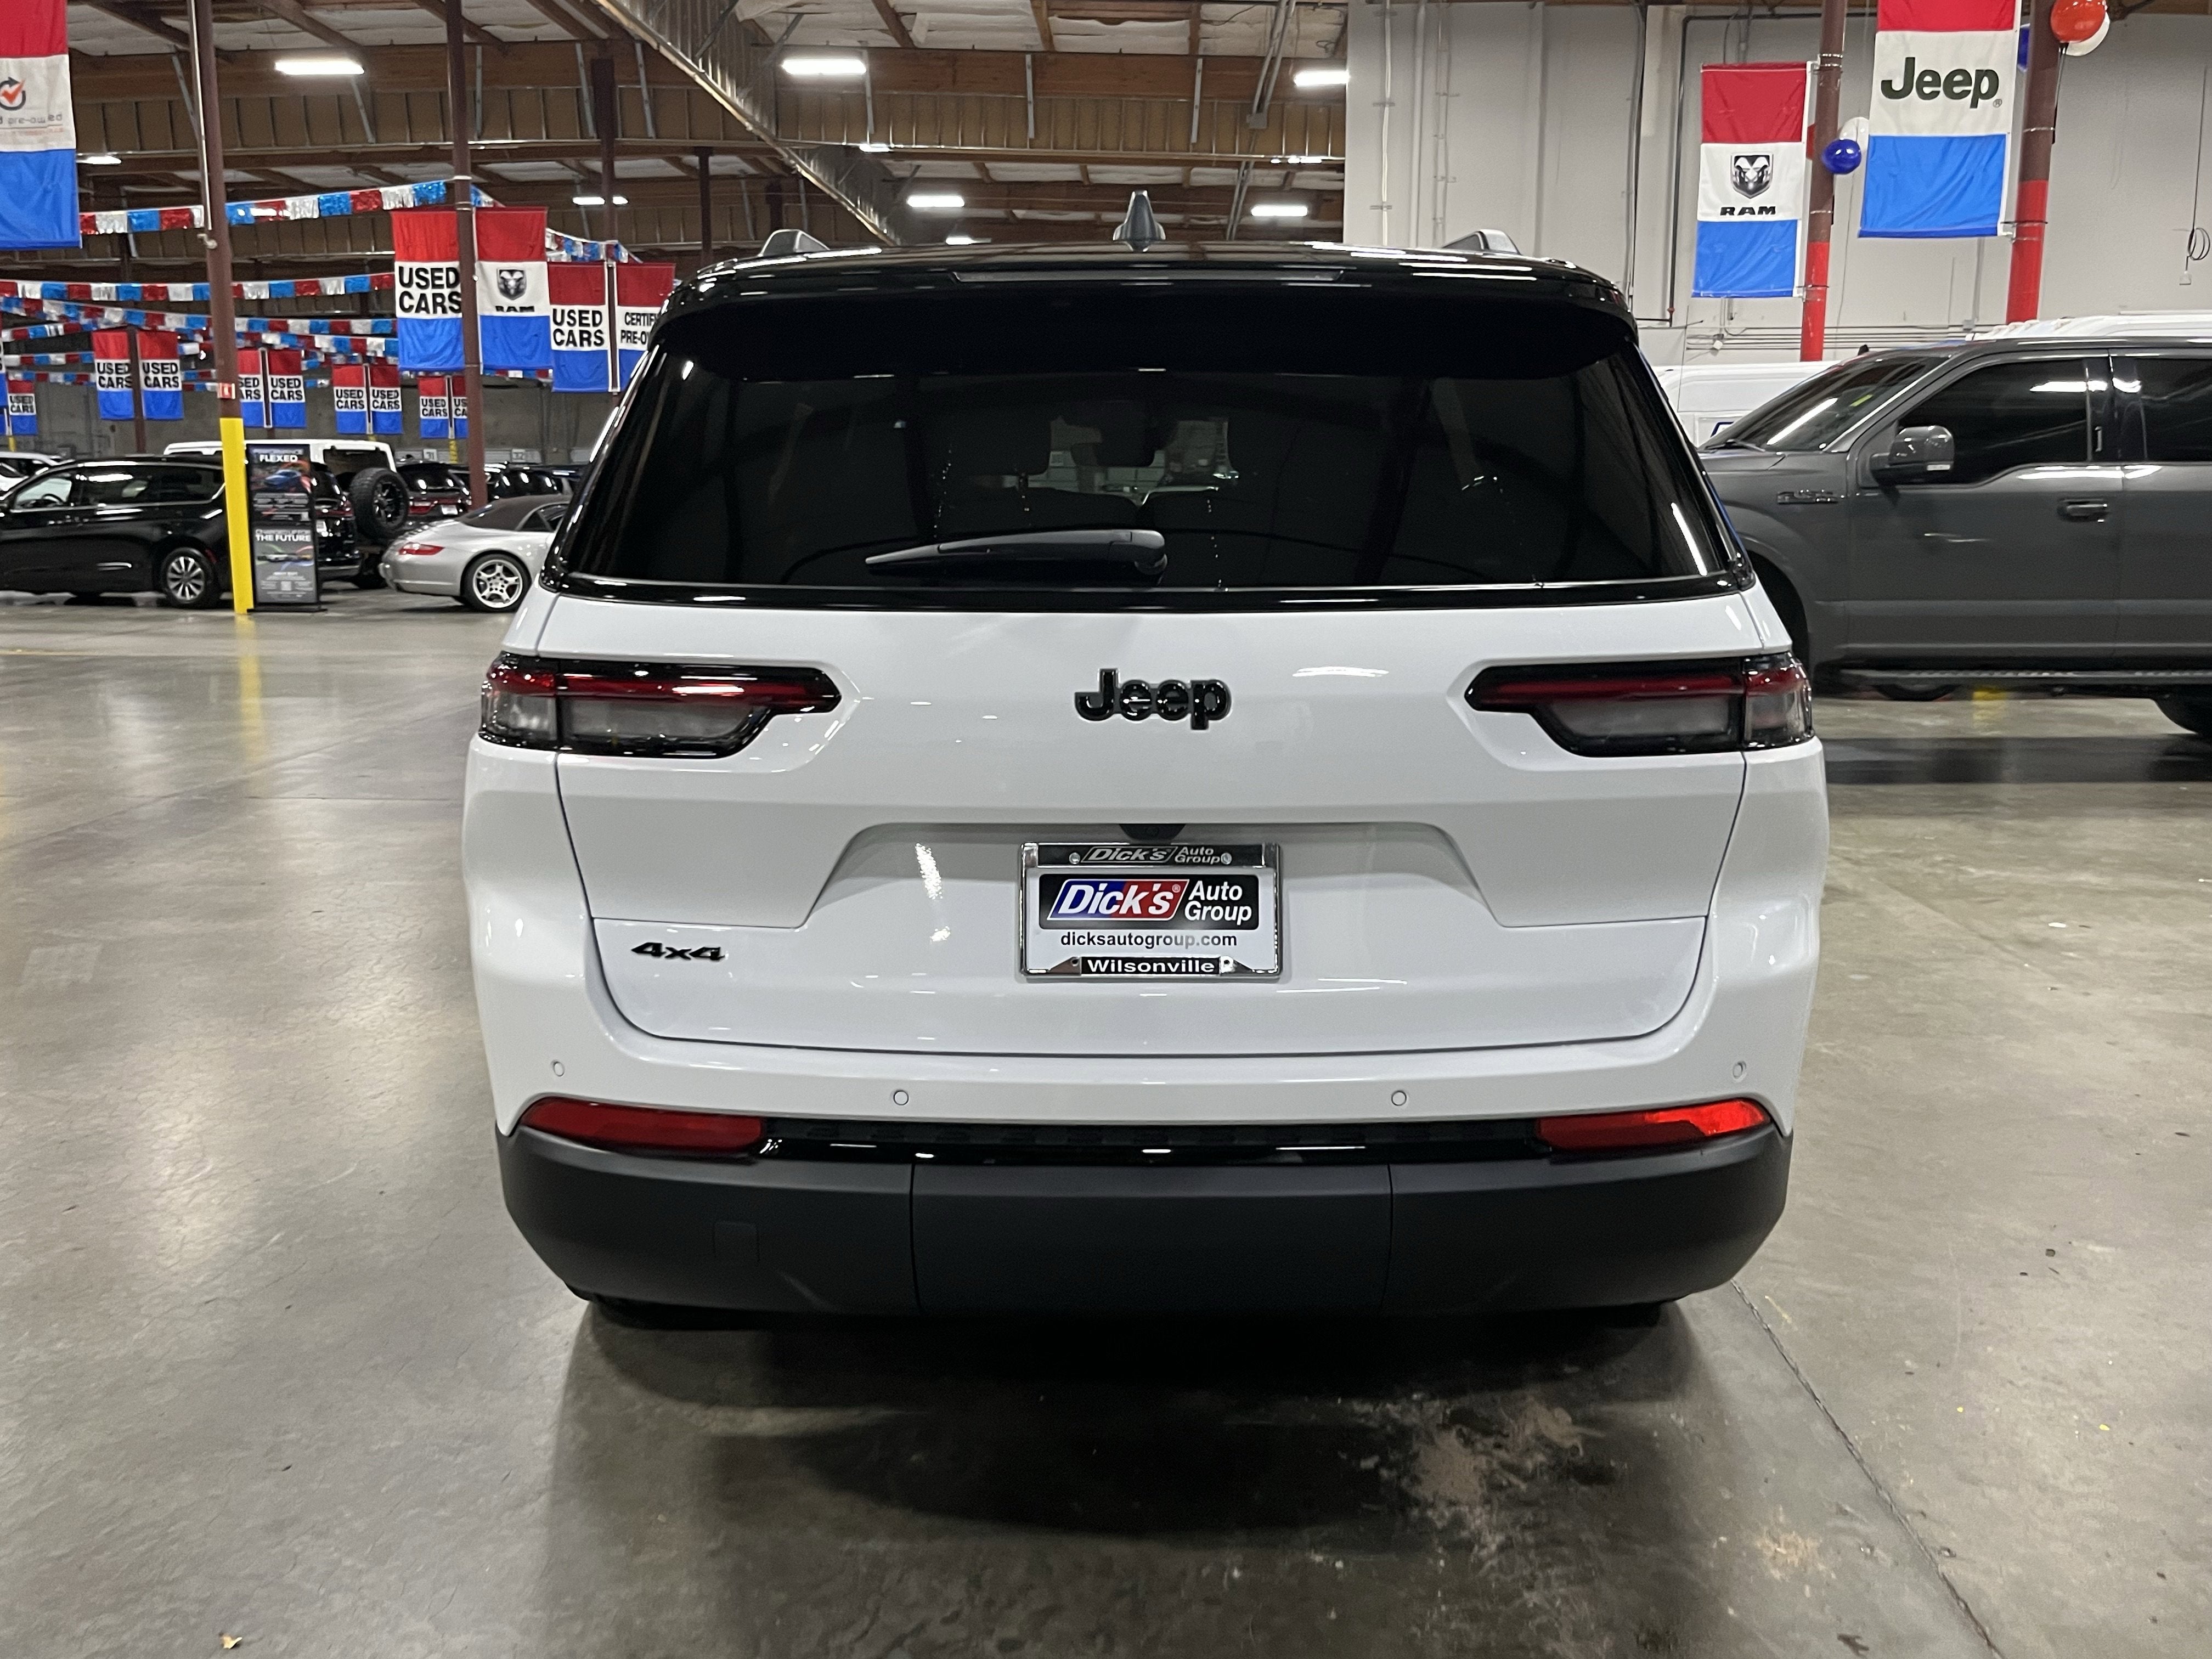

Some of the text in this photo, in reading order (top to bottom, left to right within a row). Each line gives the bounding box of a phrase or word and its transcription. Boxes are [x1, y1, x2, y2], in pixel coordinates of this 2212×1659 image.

[1881, 57, 1999, 109] Jeep
[1720, 206, 1776, 216] RAM
[399, 266, 460, 290] USED
[399, 291, 462, 314] CARS
[552, 308, 603, 327] USED
[624, 312, 657, 326] CERTIF
[552, 328, 605, 347] CARS
[620, 330, 649, 345] PRE-O
[97, 362, 131, 375] USED
[143, 362, 178, 374] USED
[98, 376, 132, 388] CARS
[144, 376, 179, 388] CARS
[238, 376, 259, 388] SED
[270, 377, 301, 389] USED
[270, 390, 303, 400] CARS
[335, 389, 364, 399] USED
[372, 389, 399, 399] USED
[336, 400, 365, 409] CARS
[372, 400, 400, 410] CARS
[421, 398, 446, 407] USED
[453, 398, 467, 407] US
[422, 408, 448, 417] CARS
[454, 408, 467, 416] CA
[1074, 668, 1232, 730] Jeep
[1088, 848, 1167, 861] Dick's
[1178, 847, 1214, 856] Auto
[1174, 854, 1221, 865] Group
[1189, 881, 1243, 901] Auto
[1058, 883, 1175, 915] Dick's
[1184, 901, 1252, 926] Group
[1060, 932, 1237, 949] dicksautogroup.com
[631, 942, 725, 961] 4x4
[1087, 959, 1215, 973] Wilsonville
